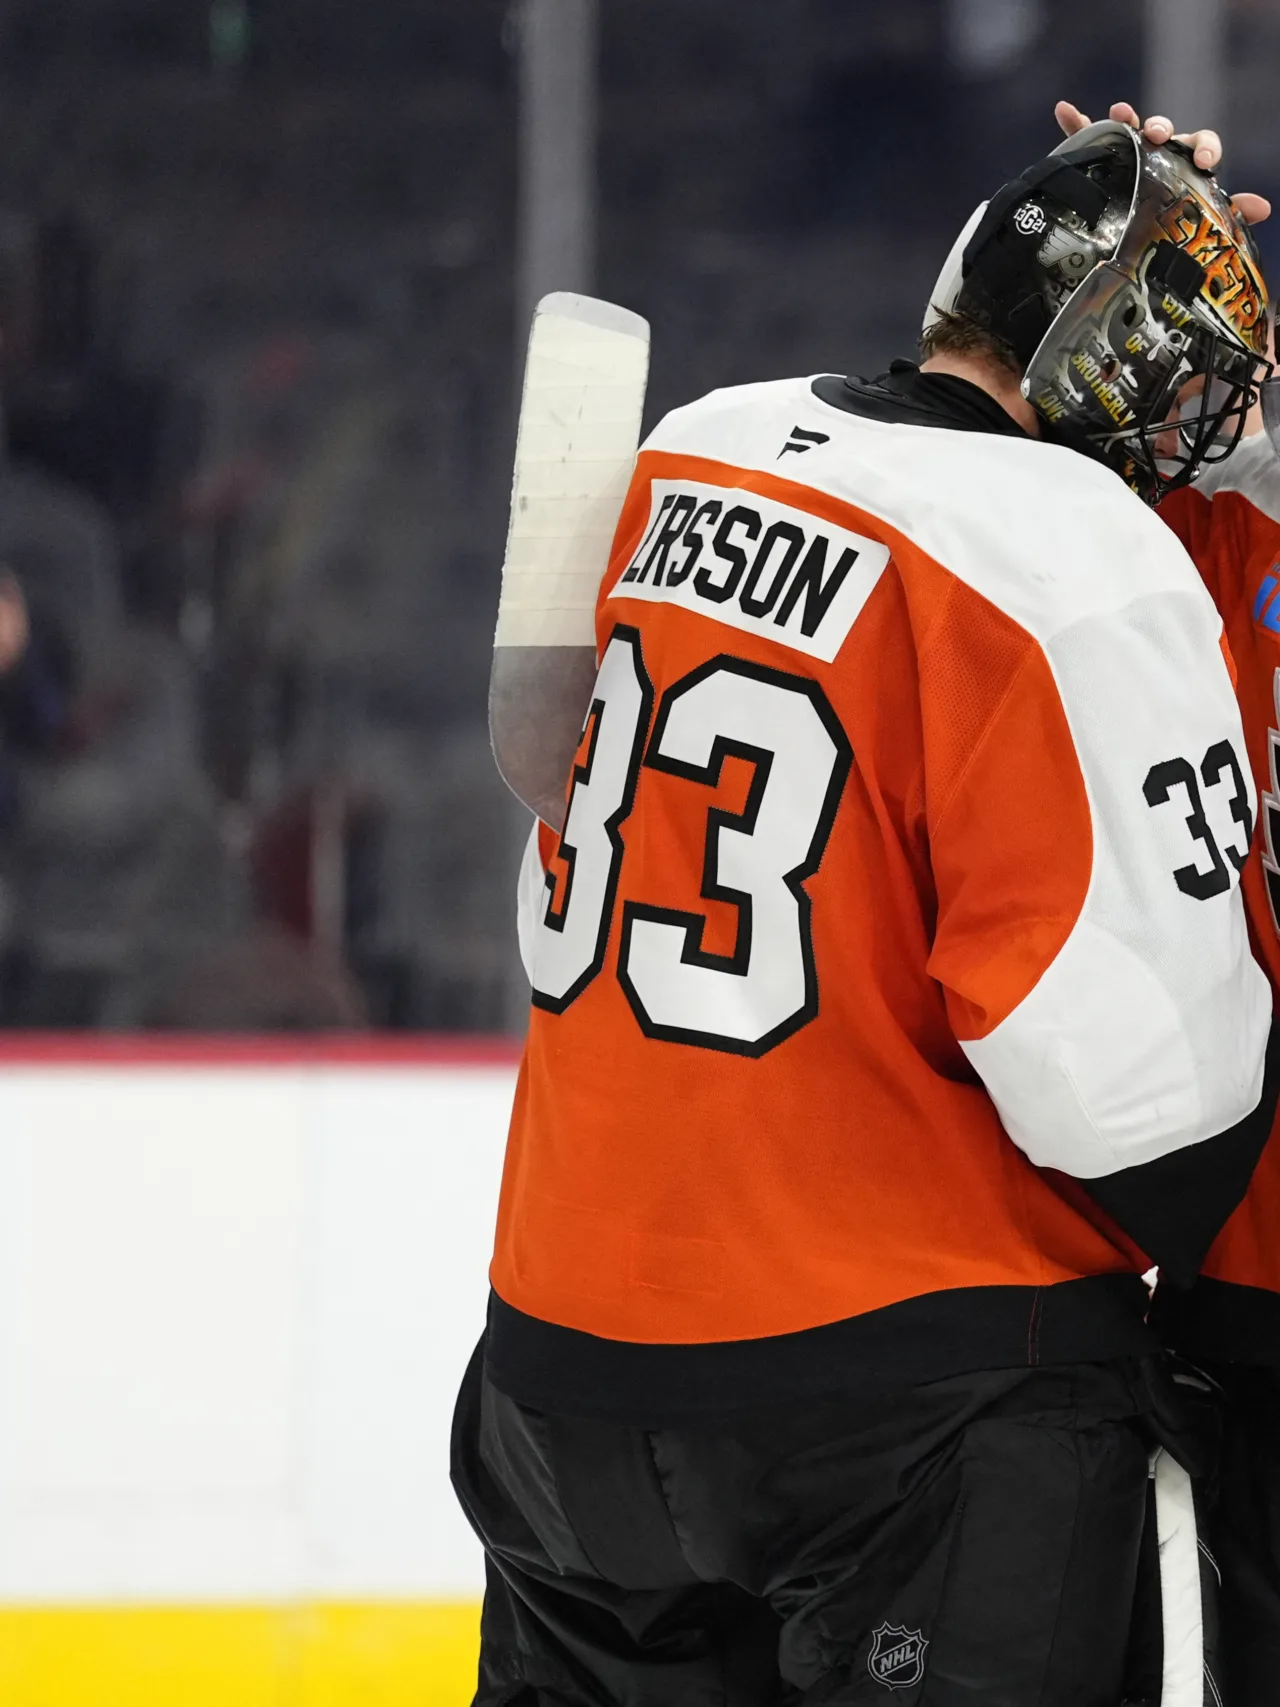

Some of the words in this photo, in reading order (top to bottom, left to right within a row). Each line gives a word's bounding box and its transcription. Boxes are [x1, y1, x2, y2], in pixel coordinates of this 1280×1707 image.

[1161, 292, 1196, 328] CITY
[1125, 332, 1150, 355] OF
[1036, 386, 1071, 423] LOVE
[1071, 349, 1137, 427] BROTHERLY
[621, 493, 860, 638] ERSSON
[1142, 739, 1258, 900] 33
[880, 1644, 916, 1674] NHL
